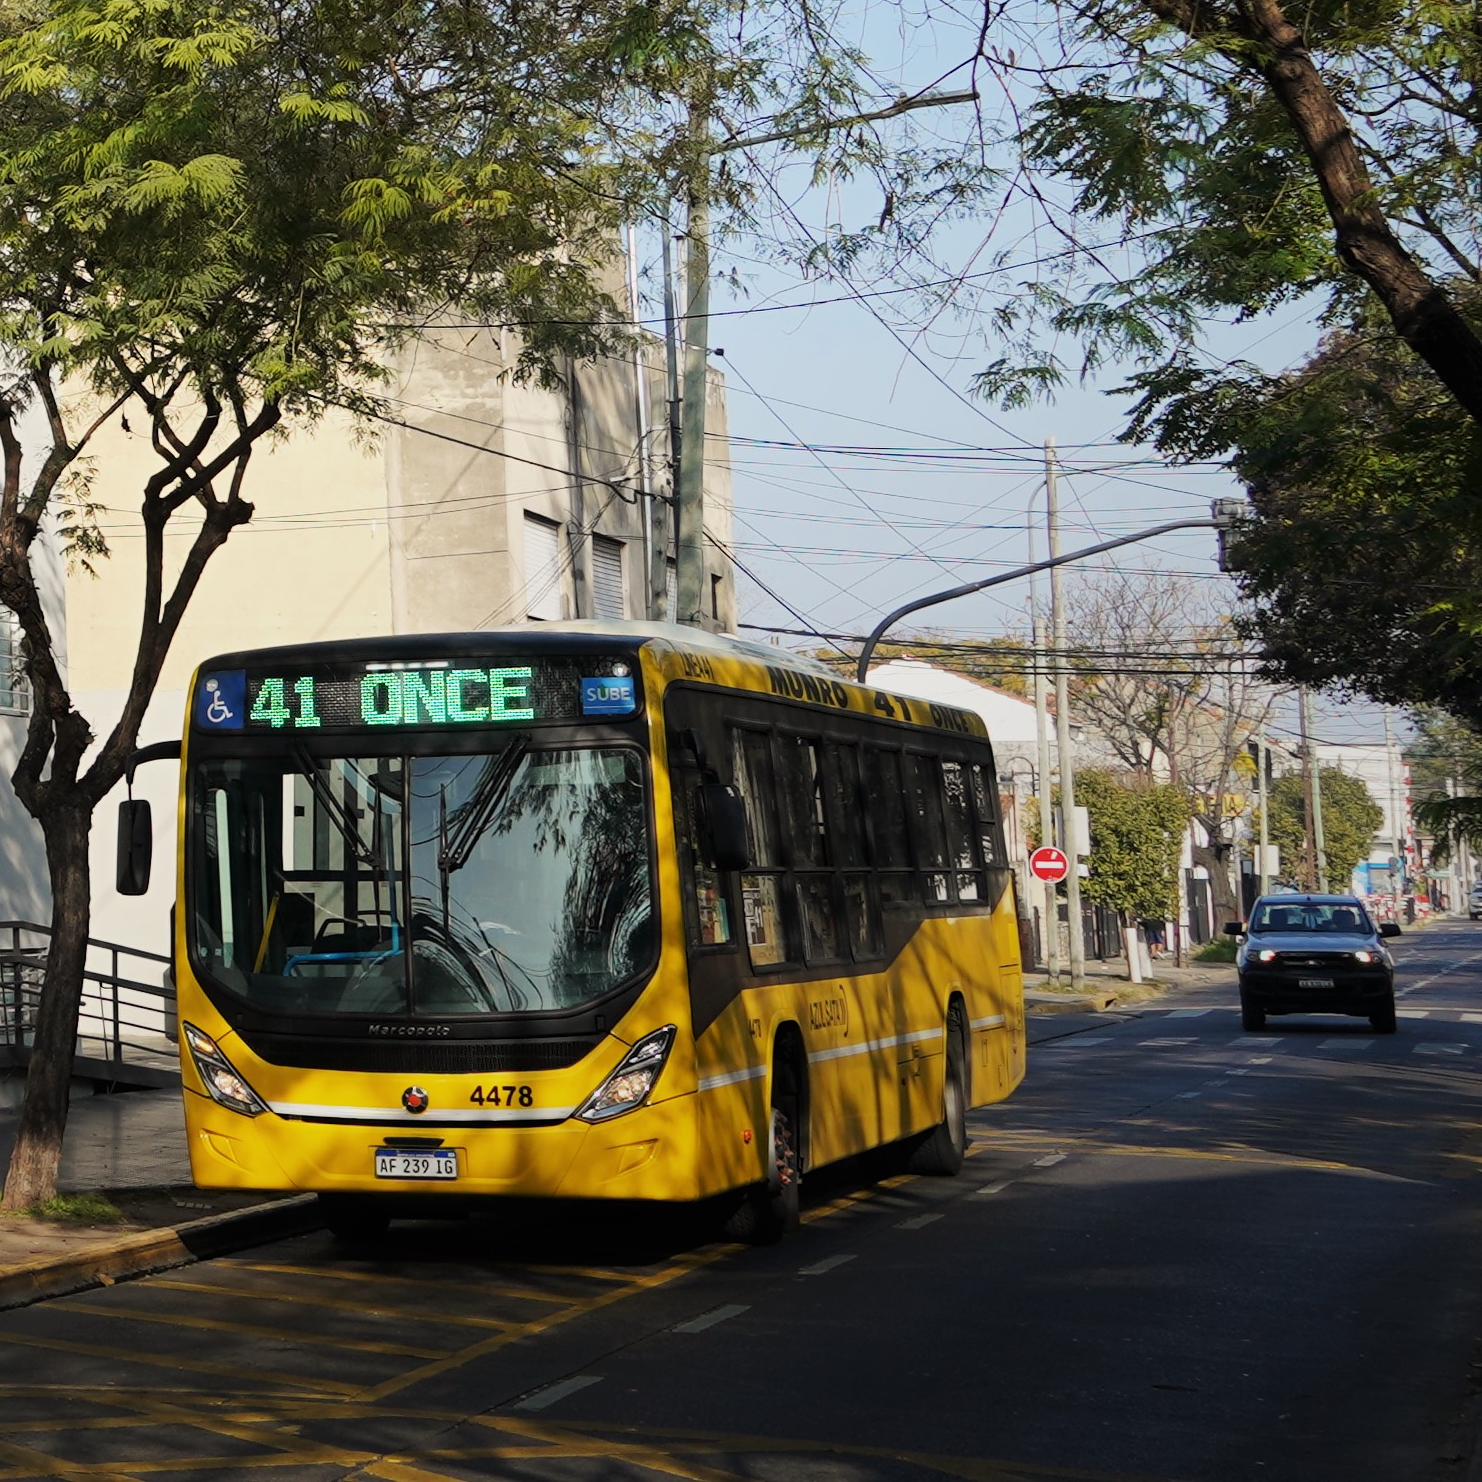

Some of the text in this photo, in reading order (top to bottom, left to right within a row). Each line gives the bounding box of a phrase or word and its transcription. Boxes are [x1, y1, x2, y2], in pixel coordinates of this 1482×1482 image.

[249, 666, 535, 728] 41 ONCE
[586, 683, 633, 703] SUBE
[767, 666, 848, 708] MUNRO
[873, 691, 913, 722] 41
[368, 1024, 451, 1037] Marcopolo
[469, 1084, 534, 1108] 4478
[379, 1158, 397, 1174] AF
[402, 1158, 430, 1175] 239
